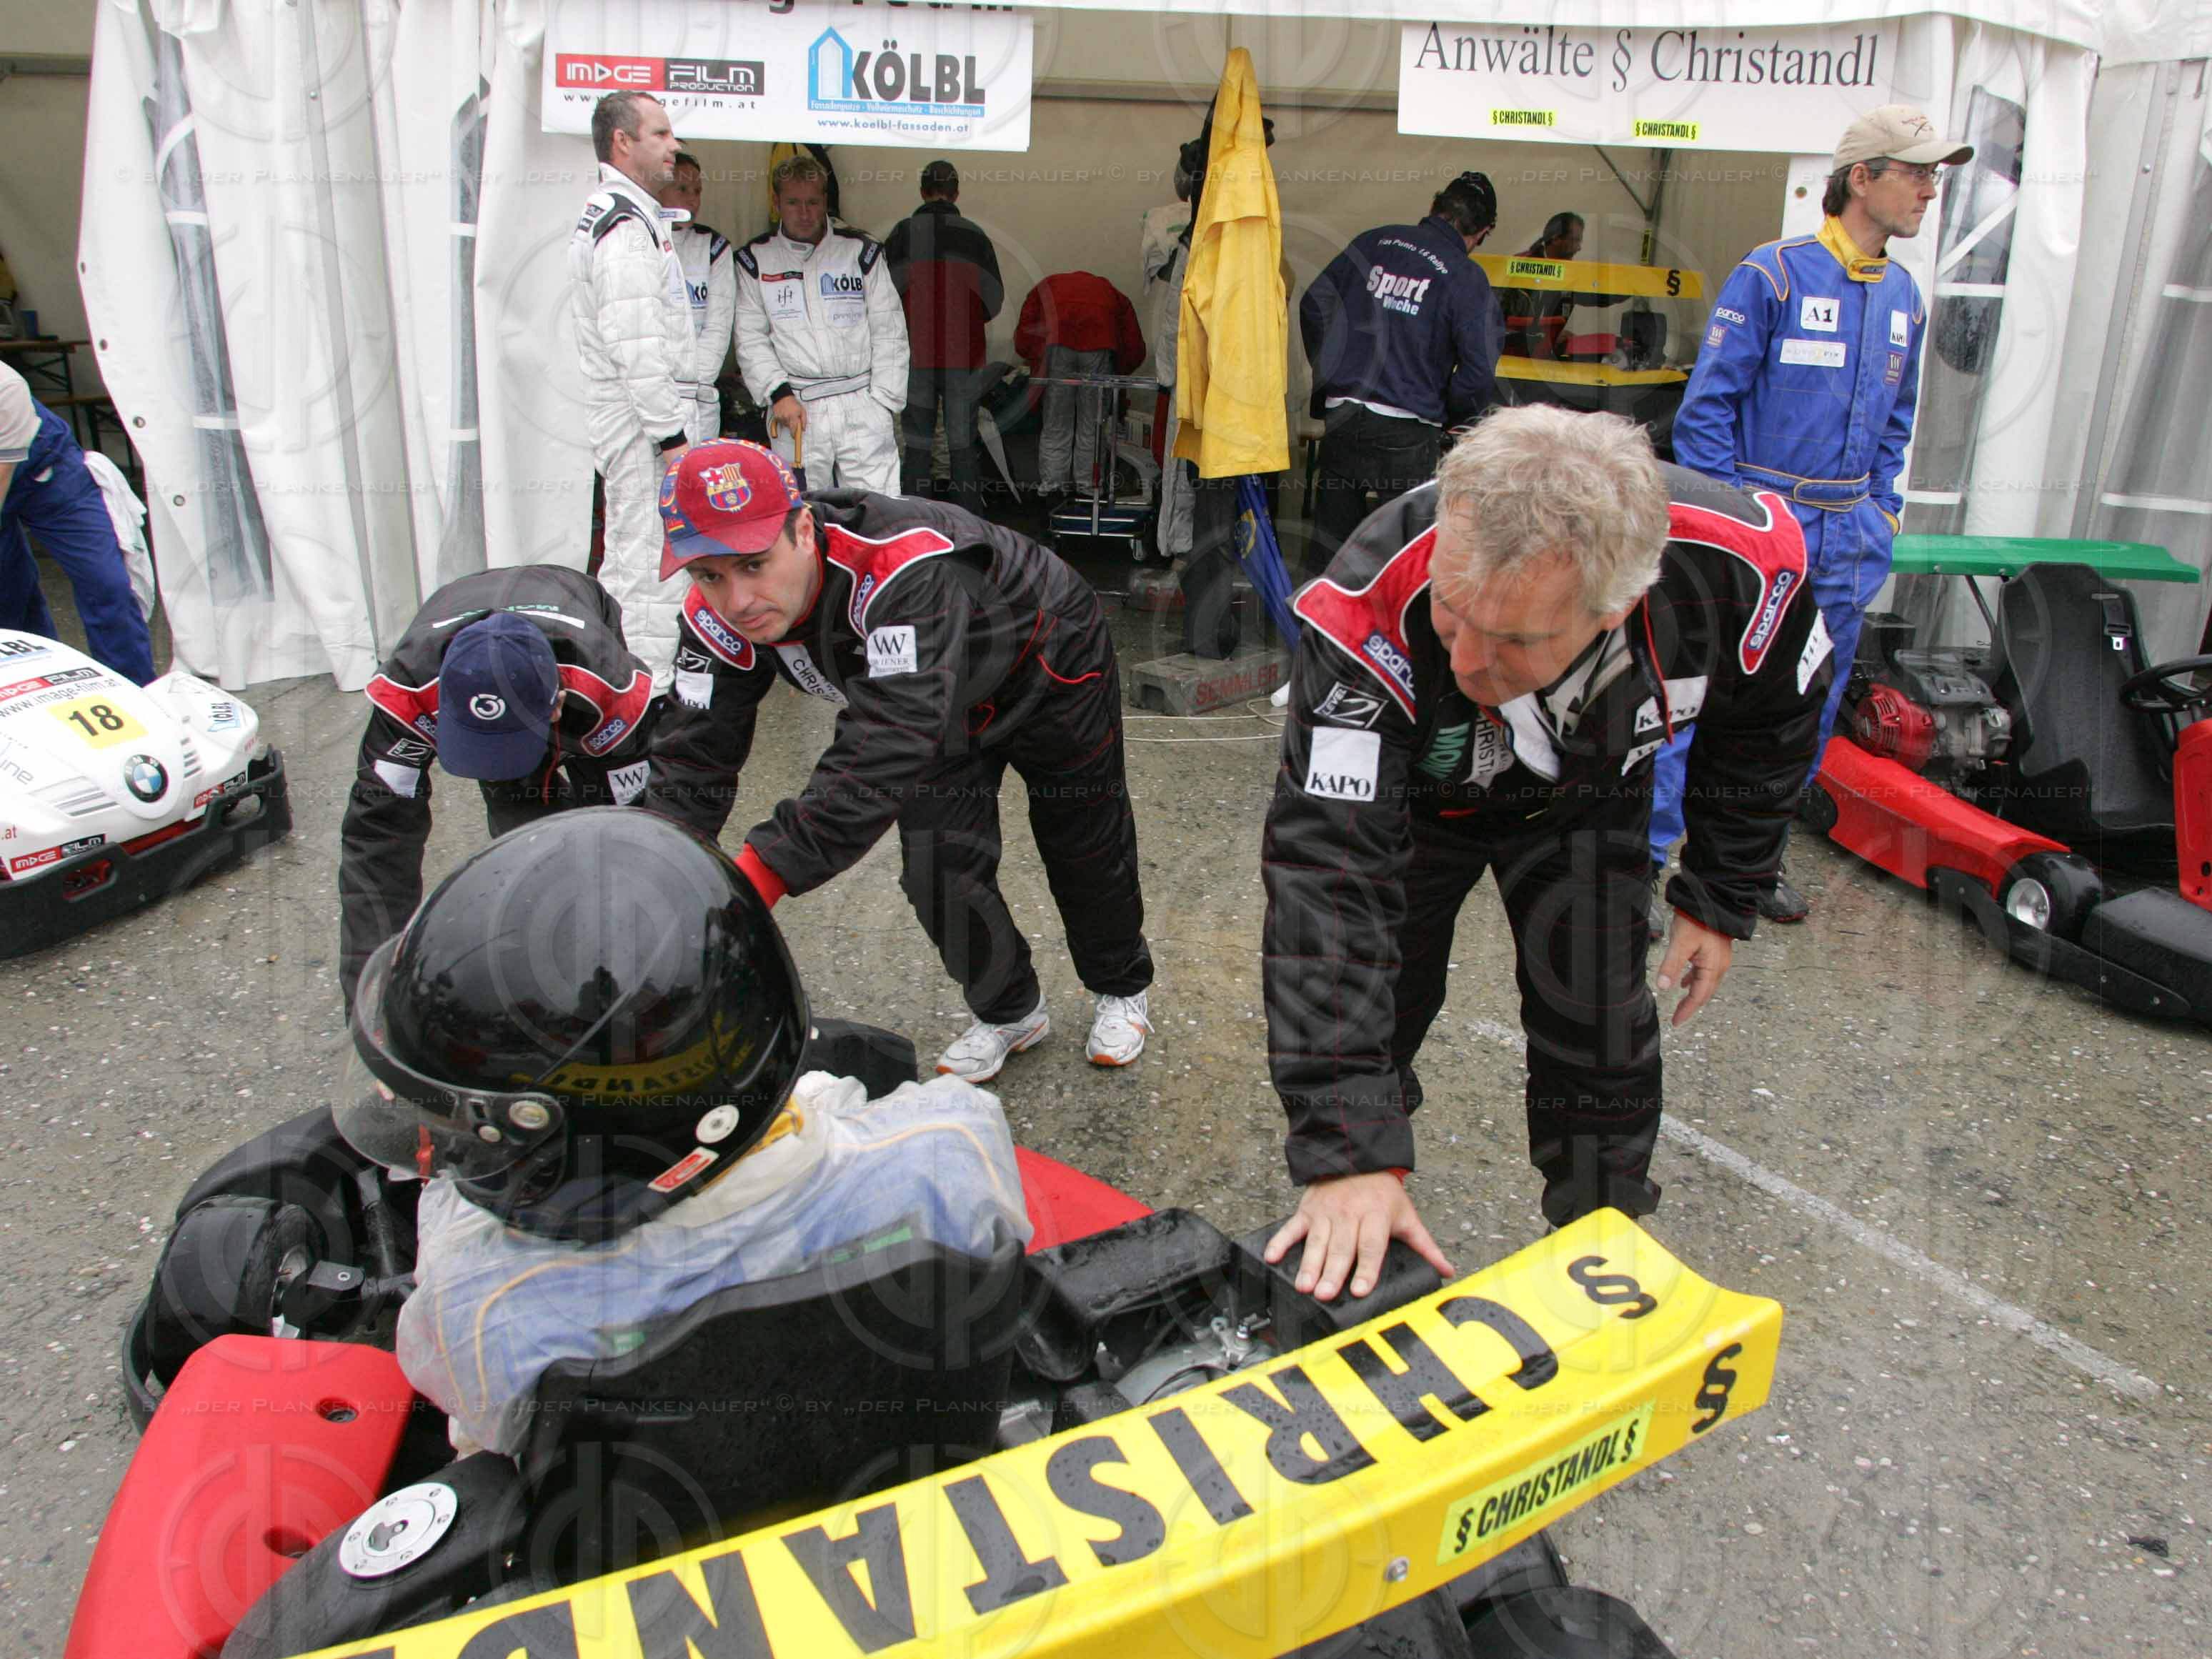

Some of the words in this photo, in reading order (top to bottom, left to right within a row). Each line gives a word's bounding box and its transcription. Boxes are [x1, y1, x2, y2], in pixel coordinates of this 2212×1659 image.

[852, 39, 985, 104] KÖLBL
[1415, 21, 1595, 76] Anwälte
[1612, 29, 1632, 91] §
[1651, 31, 1878, 87] Christandl
[669, 64, 754, 84] FILM
[669, 82, 754, 92] PRODUCTION
[817, 118, 969, 133] www.koelbl-fassaden.at
[1500, 111, 1546, 126] CHRISTANDL
[1643, 122, 1689, 139] CHRISTANDL
[1366, 265, 1431, 303] Sport
[1515, 261, 1556, 276] CHRISTANDL
[1750, 572, 1795, 649] sparco
[694, 609, 742, 655] sparco
[1367, 634, 1414, 689] sparc
[69, 704, 124, 737] 18
[1310, 771, 1372, 797] KAPO
[336, 1295, 1559, 1659] CHRISTAN
[1478, 1439, 1620, 1537] CHRISTANDL
